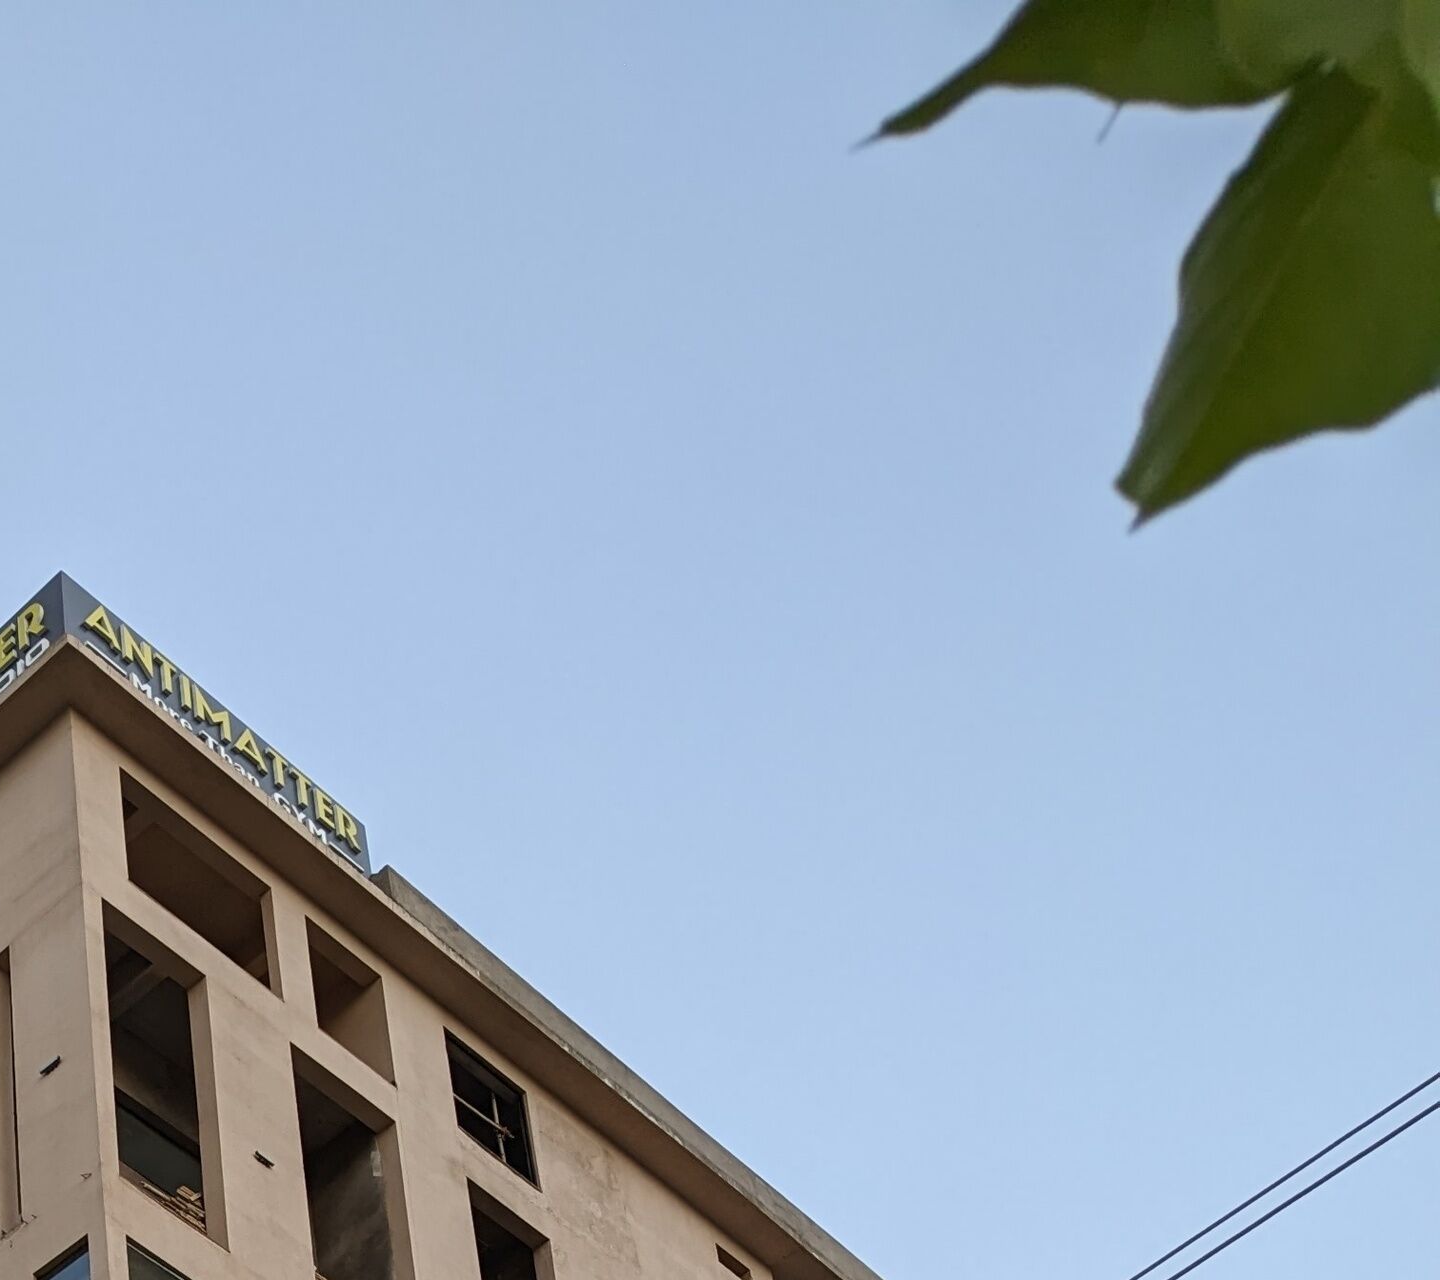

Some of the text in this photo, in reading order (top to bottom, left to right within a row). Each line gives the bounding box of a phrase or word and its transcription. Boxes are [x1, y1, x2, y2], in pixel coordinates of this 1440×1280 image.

[84, 605, 362, 853] ANTIMATTER
[128, 672, 328, 845] More Than GYM
